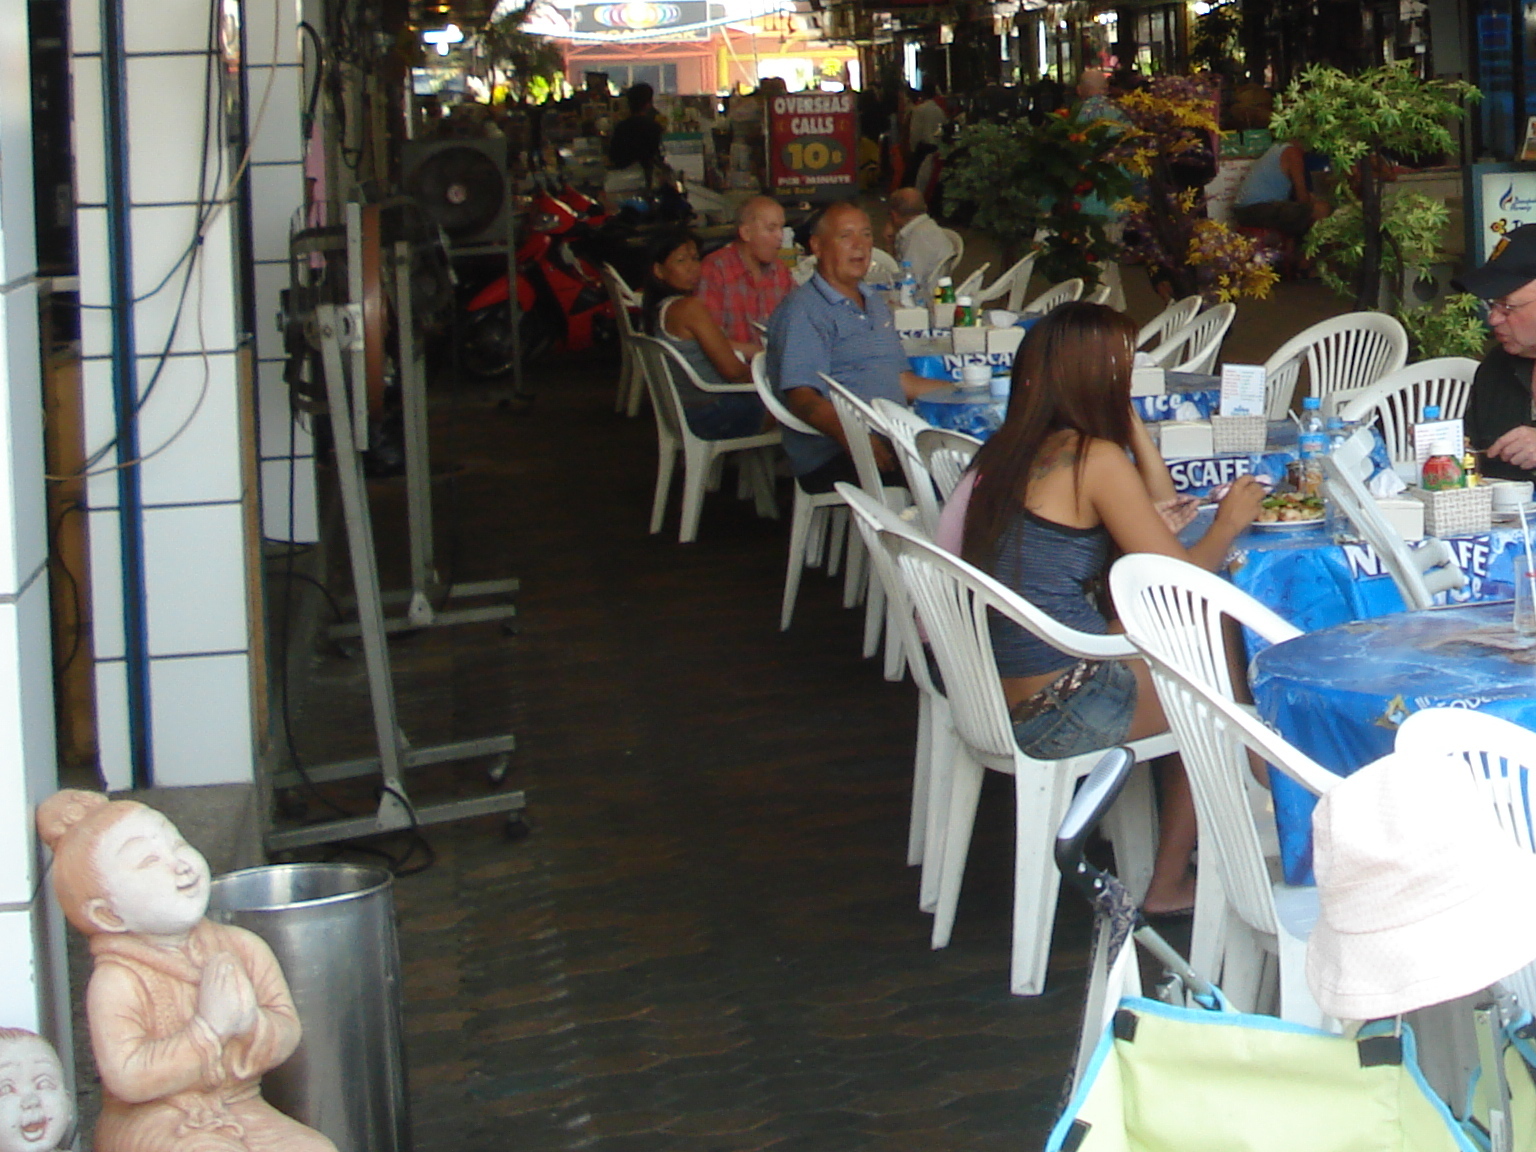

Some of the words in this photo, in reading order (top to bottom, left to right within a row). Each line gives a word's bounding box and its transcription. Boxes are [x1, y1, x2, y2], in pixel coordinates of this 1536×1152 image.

[774, 96, 851, 115] OVERSEAS
[791, 116, 834, 135] CALLS
[778, 176, 800, 186] PER
[805, 174, 851, 185] MINUTE
